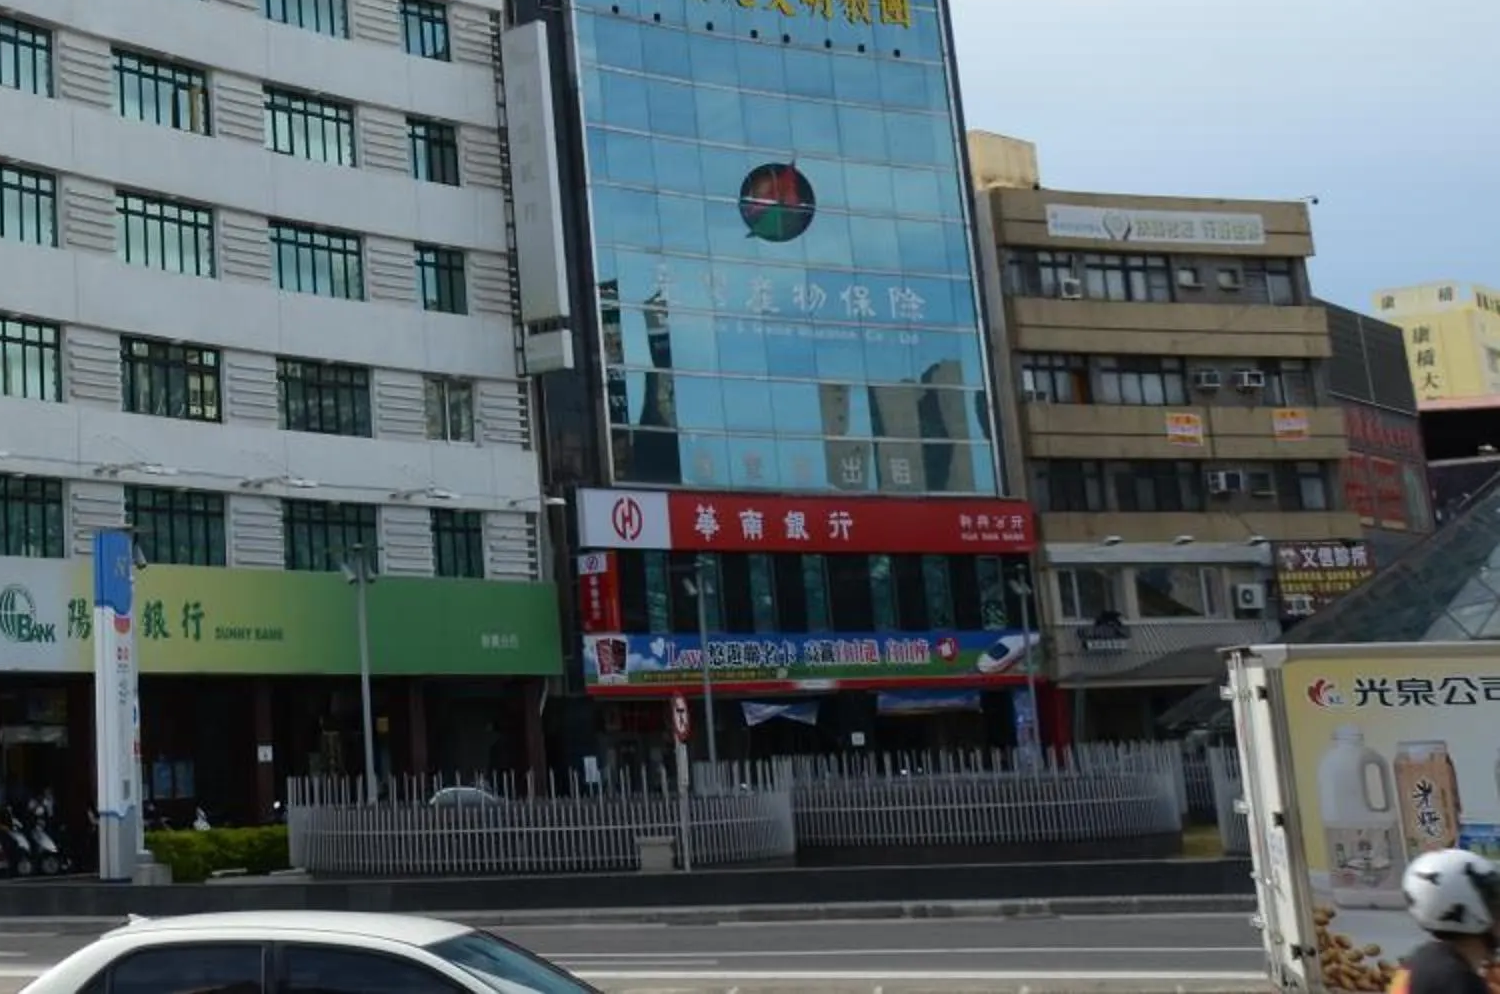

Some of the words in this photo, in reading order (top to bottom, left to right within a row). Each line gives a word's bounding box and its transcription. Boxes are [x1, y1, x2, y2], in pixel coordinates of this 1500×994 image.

[653, 262, 927, 321] 產物保險
[1412, 325, 1440, 400] 康橋大
[694, 505, 854, 541] 華南銀行
[18, 619, 56, 643] BANK
[67, 599, 205, 642] 陽銀行
